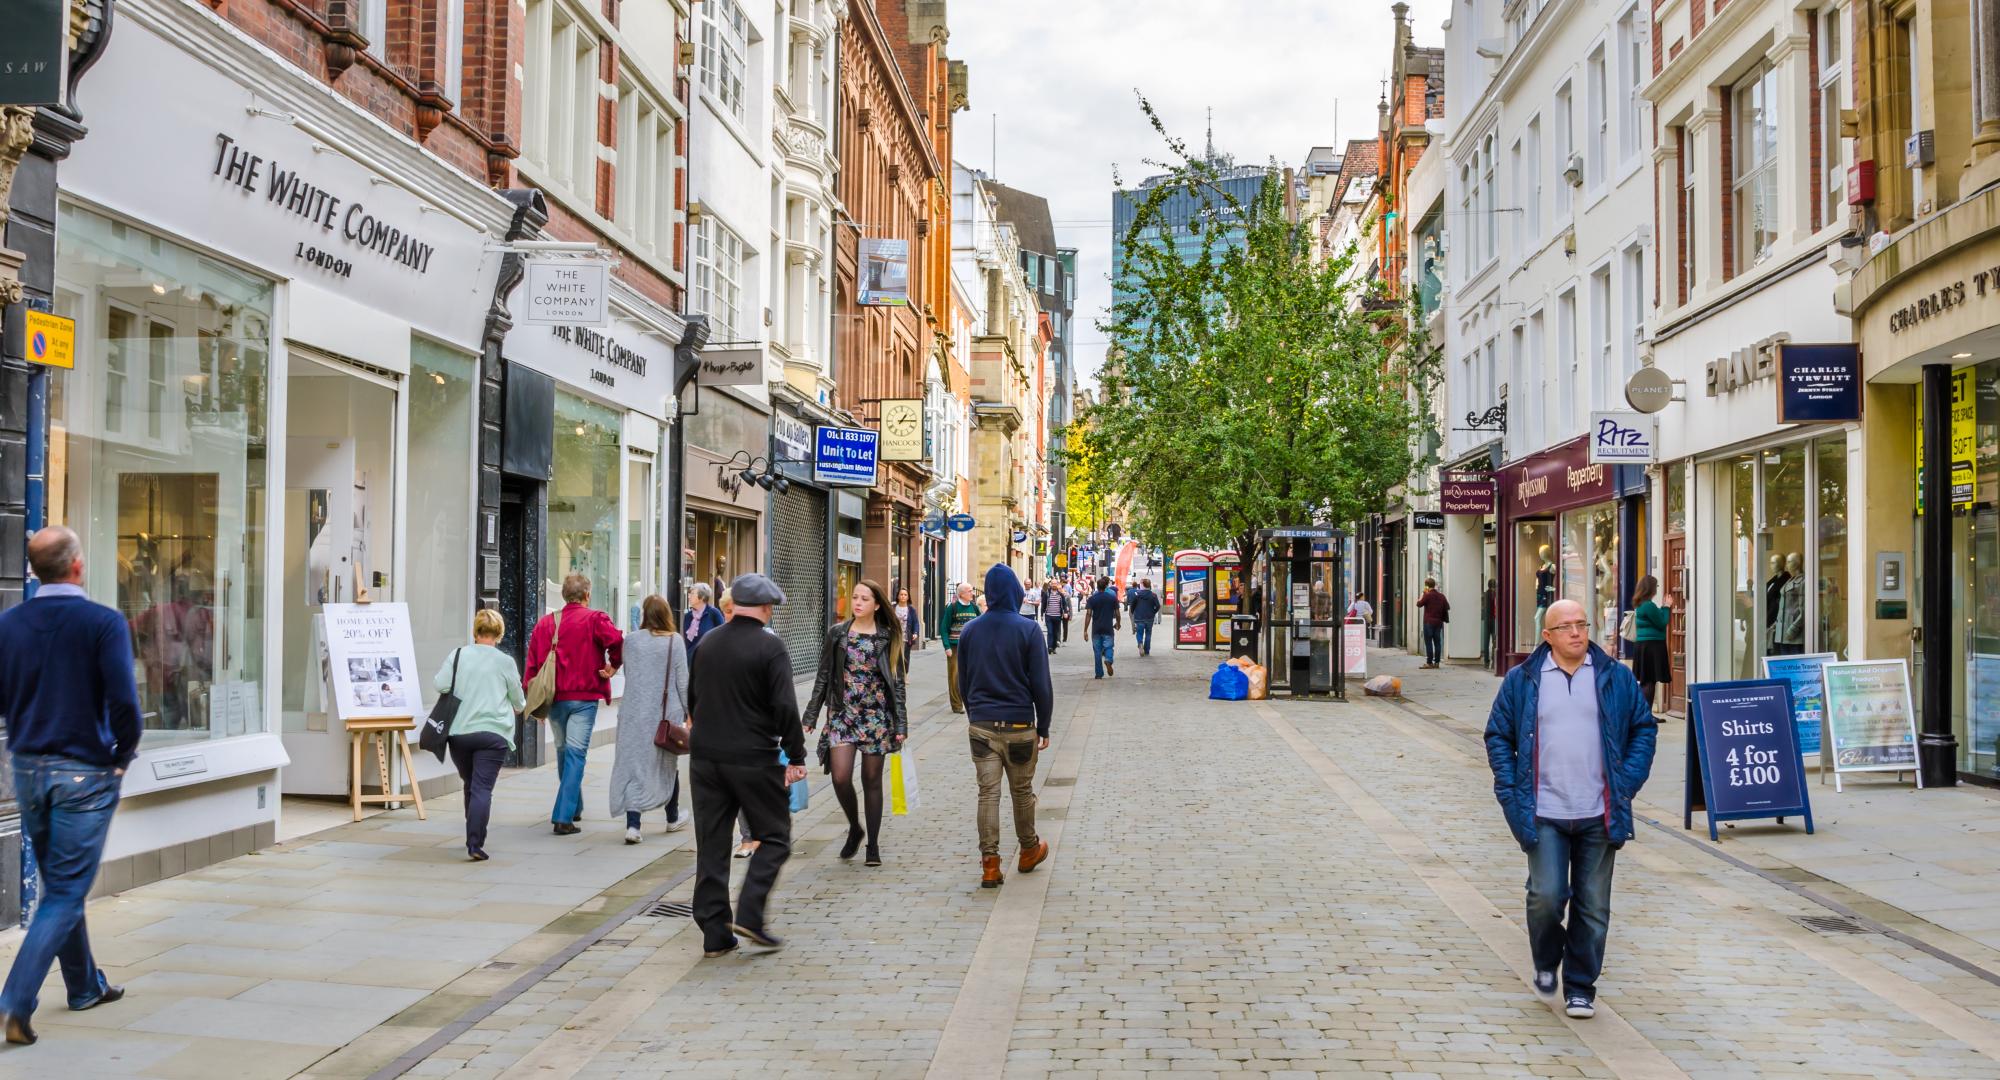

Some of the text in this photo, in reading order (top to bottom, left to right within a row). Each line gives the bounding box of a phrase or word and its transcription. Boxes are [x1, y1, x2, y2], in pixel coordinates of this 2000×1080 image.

[214, 132, 434, 273] THE WHITE COMPANY
[295, 242, 352, 278] LONDON
[556, 270, 578, 280] THE
[547, 283, 586, 293] WHITE
[534, 296, 596, 306] COMPANY
[1890, 280, 1966, 334] CHARLES
[546, 309, 583, 317] LONDON
[30, 314, 73, 333] Pedestrian Zone
[575, 326, 605, 358] WHITE
[607, 337, 648, 377] COMPANY
[590, 368, 615, 388] LONDON
[1790, 374, 1851, 382] TYRWHITT
[1631, 386, 1668, 394] PLANET
[845, 432, 859, 442] 833
[859, 434, 875, 443] 1197
[882, 439, 921, 447] HANCOCKS
[823, 445, 844, 458] Unit
[845, 448, 857, 459] To
[858, 450, 873, 461] Let
[1444, 484, 1491, 499] BRAVISSIMO
[1518, 467, 1548, 508] BRAVISSIMO
[1445, 500, 1490, 511] Pepperberry
[366, 617, 396, 625] EVENT
[343, 628, 393, 638] 20% OFF
[1742, 695, 1775, 703] TYRWHITT
[1721, 720, 1774, 737] Shirts
[1726, 744, 1779, 766] 4 for
[1729, 765, 1781, 787] £100
